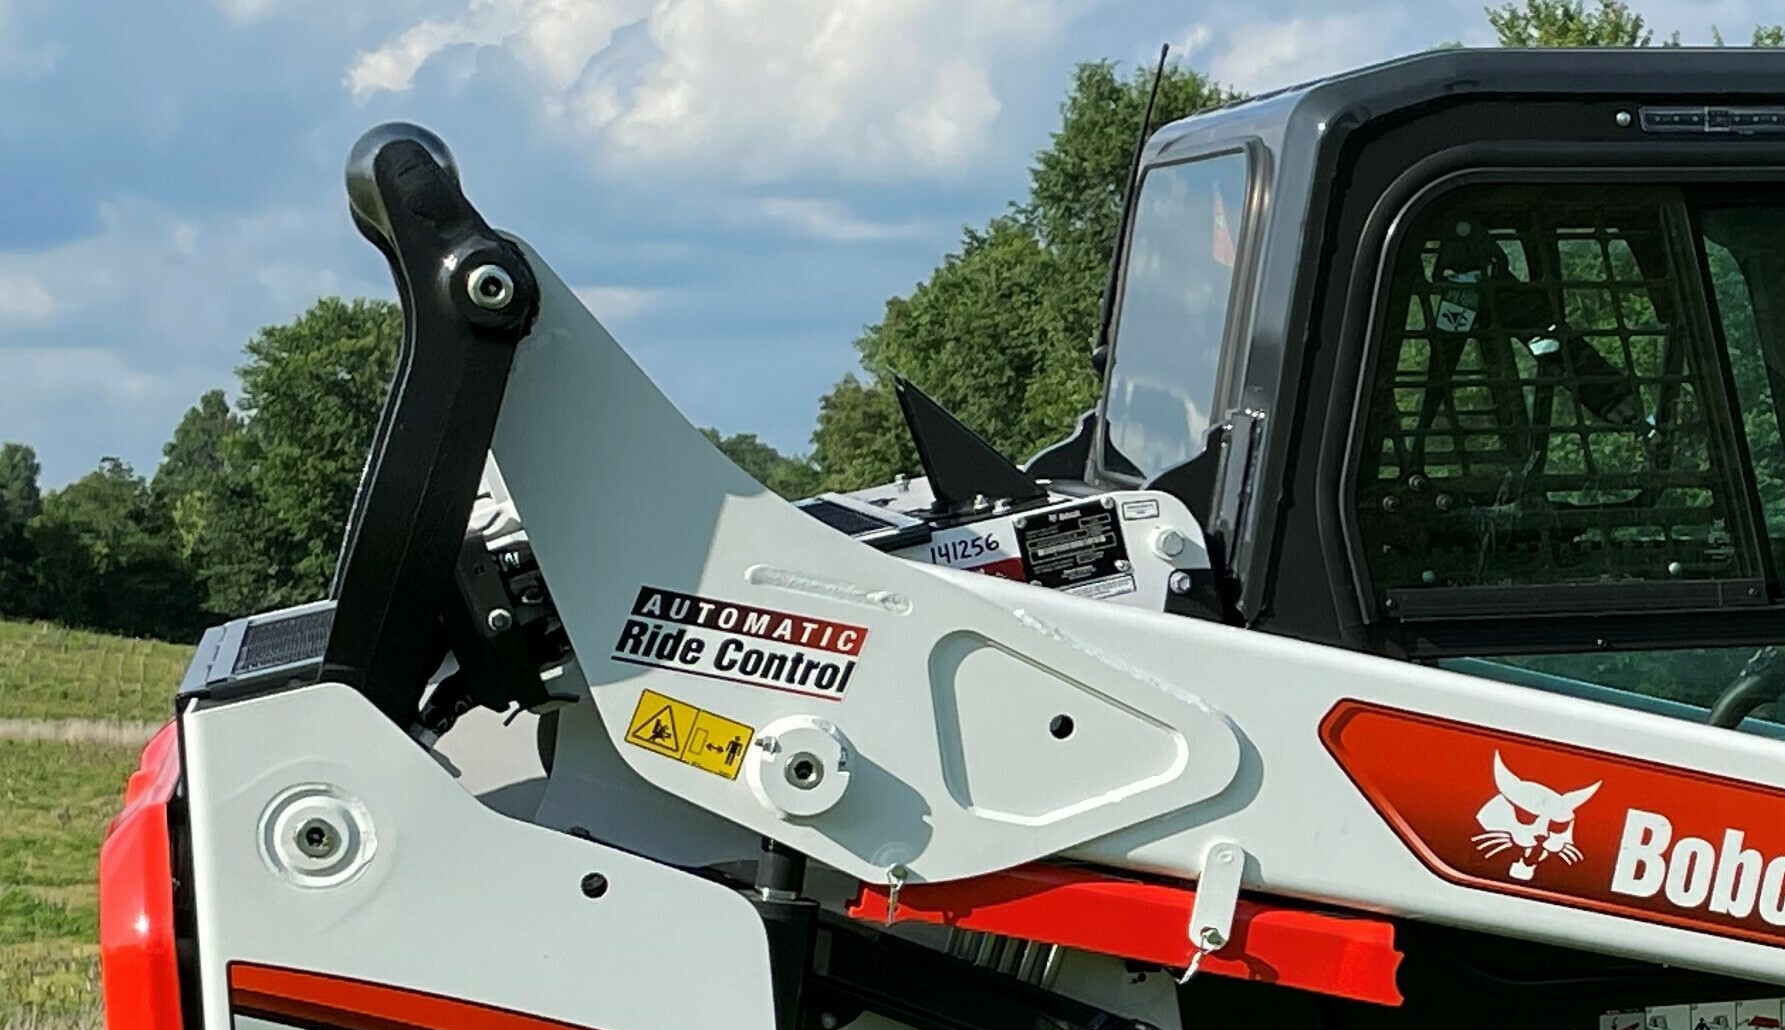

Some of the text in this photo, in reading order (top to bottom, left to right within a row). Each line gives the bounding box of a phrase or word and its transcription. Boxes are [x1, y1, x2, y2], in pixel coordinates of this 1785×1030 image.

[930, 532, 1000, 565] 141256
[641, 593, 858, 651] AUTOMATIC
[614, 619, 856, 693] Ride Control
